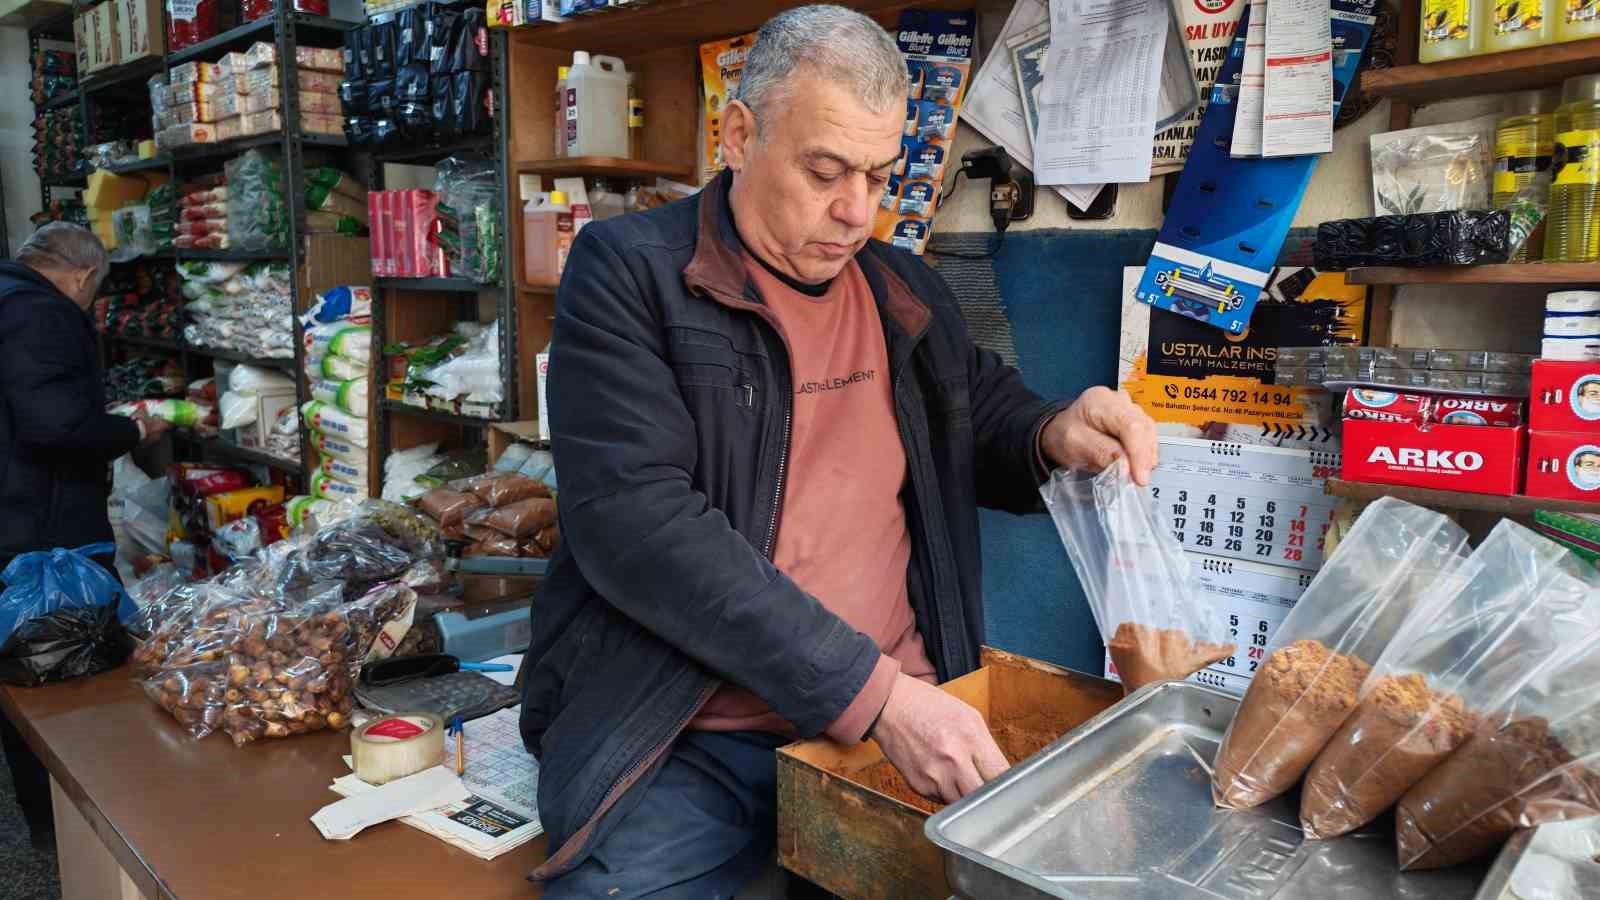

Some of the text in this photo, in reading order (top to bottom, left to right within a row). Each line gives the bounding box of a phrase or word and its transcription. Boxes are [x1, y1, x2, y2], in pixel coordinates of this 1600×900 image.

[1338, 12, 1369, 22] COMFORT
[899, 30, 934, 44] Gillette
[937, 33, 972, 47] Gillette
[1186, 24, 1208, 40] SAL
[716, 47, 749, 66] Gille
[720, 67, 744, 81] Perm
[1230, 320, 1243, 332] 5T
[1161, 342, 1241, 360] USTALAR
[1177, 358, 1274, 372] YAPI MALZEMEL
[1184, 386, 1291, 406] 0544 792 14 94
[1442, 398, 1508, 413] ARKO
[1367, 445, 1485, 471] ARKO
[1152, 487, 1307, 518] 2 3 4 5 6 7
[1172, 504, 1187, 516] 10
[1203, 507, 1216, 520] 11
[1230, 511, 1244, 523] 12
[1259, 515, 1274, 528] 13
[1290, 519, 1305, 532] 14
[1173, 517, 1186, 529] 17
[1200, 521, 1214, 533] 18
[1229, 525, 1243, 538] 19
[1255, 529, 1273, 542] 20
[1288, 533, 1304, 547] 21
[1196, 534, 1213, 547] 25
[1224, 538, 1242, 552] 26
[1256, 543, 1273, 556] 27
[1283, 548, 1302, 561] 28
[1229, 614, 1268, 633] 5 6
[1252, 633, 1266, 646] 13
[1249, 661, 1258, 672] 2
